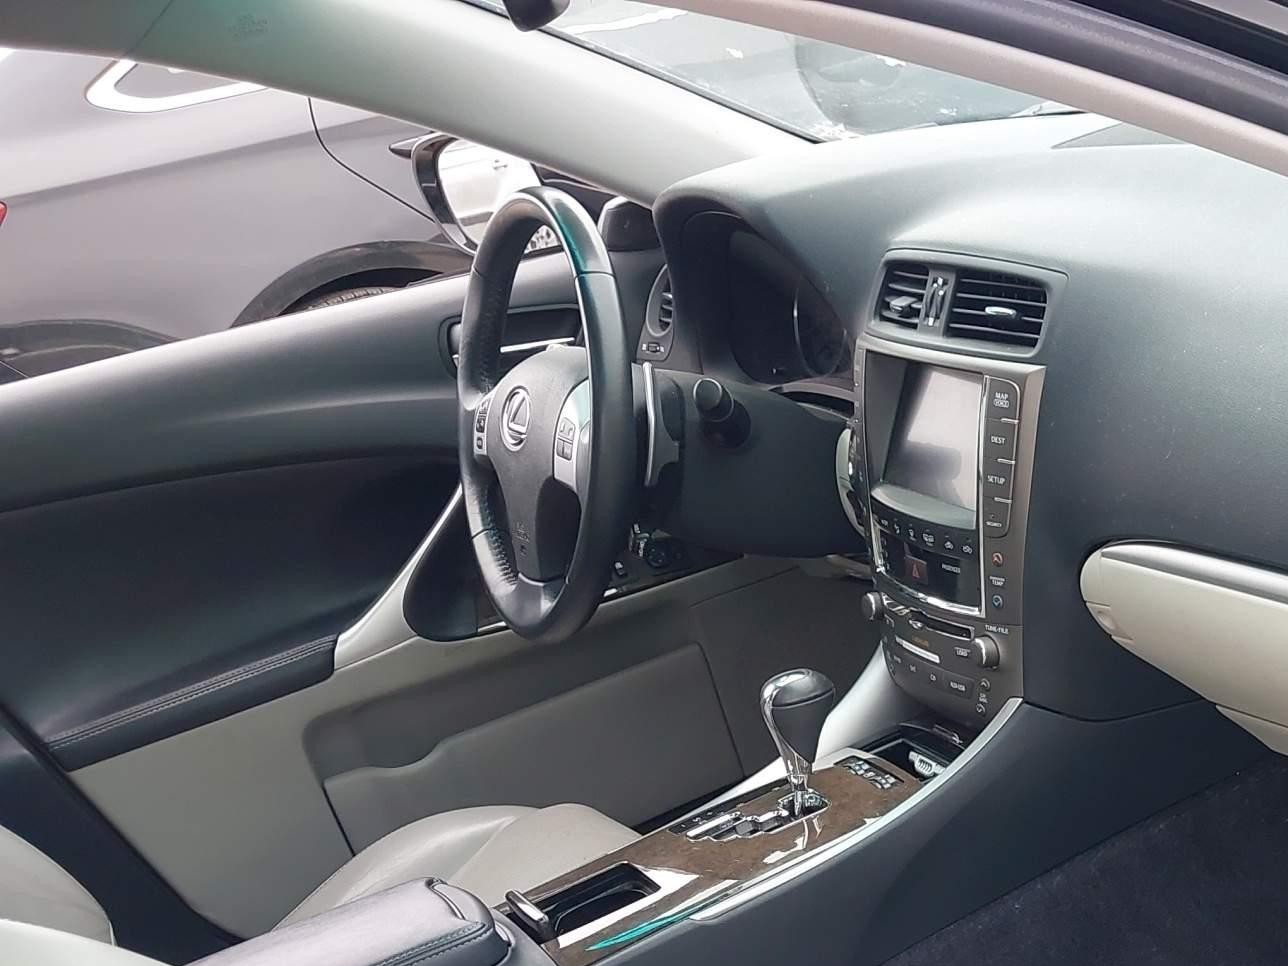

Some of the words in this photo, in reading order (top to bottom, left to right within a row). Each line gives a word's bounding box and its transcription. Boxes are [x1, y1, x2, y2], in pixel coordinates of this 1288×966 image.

[995, 391, 1008, 400] MAP
[991, 436, 1005, 444] DEST
[987, 475, 1005, 485] SETUP
